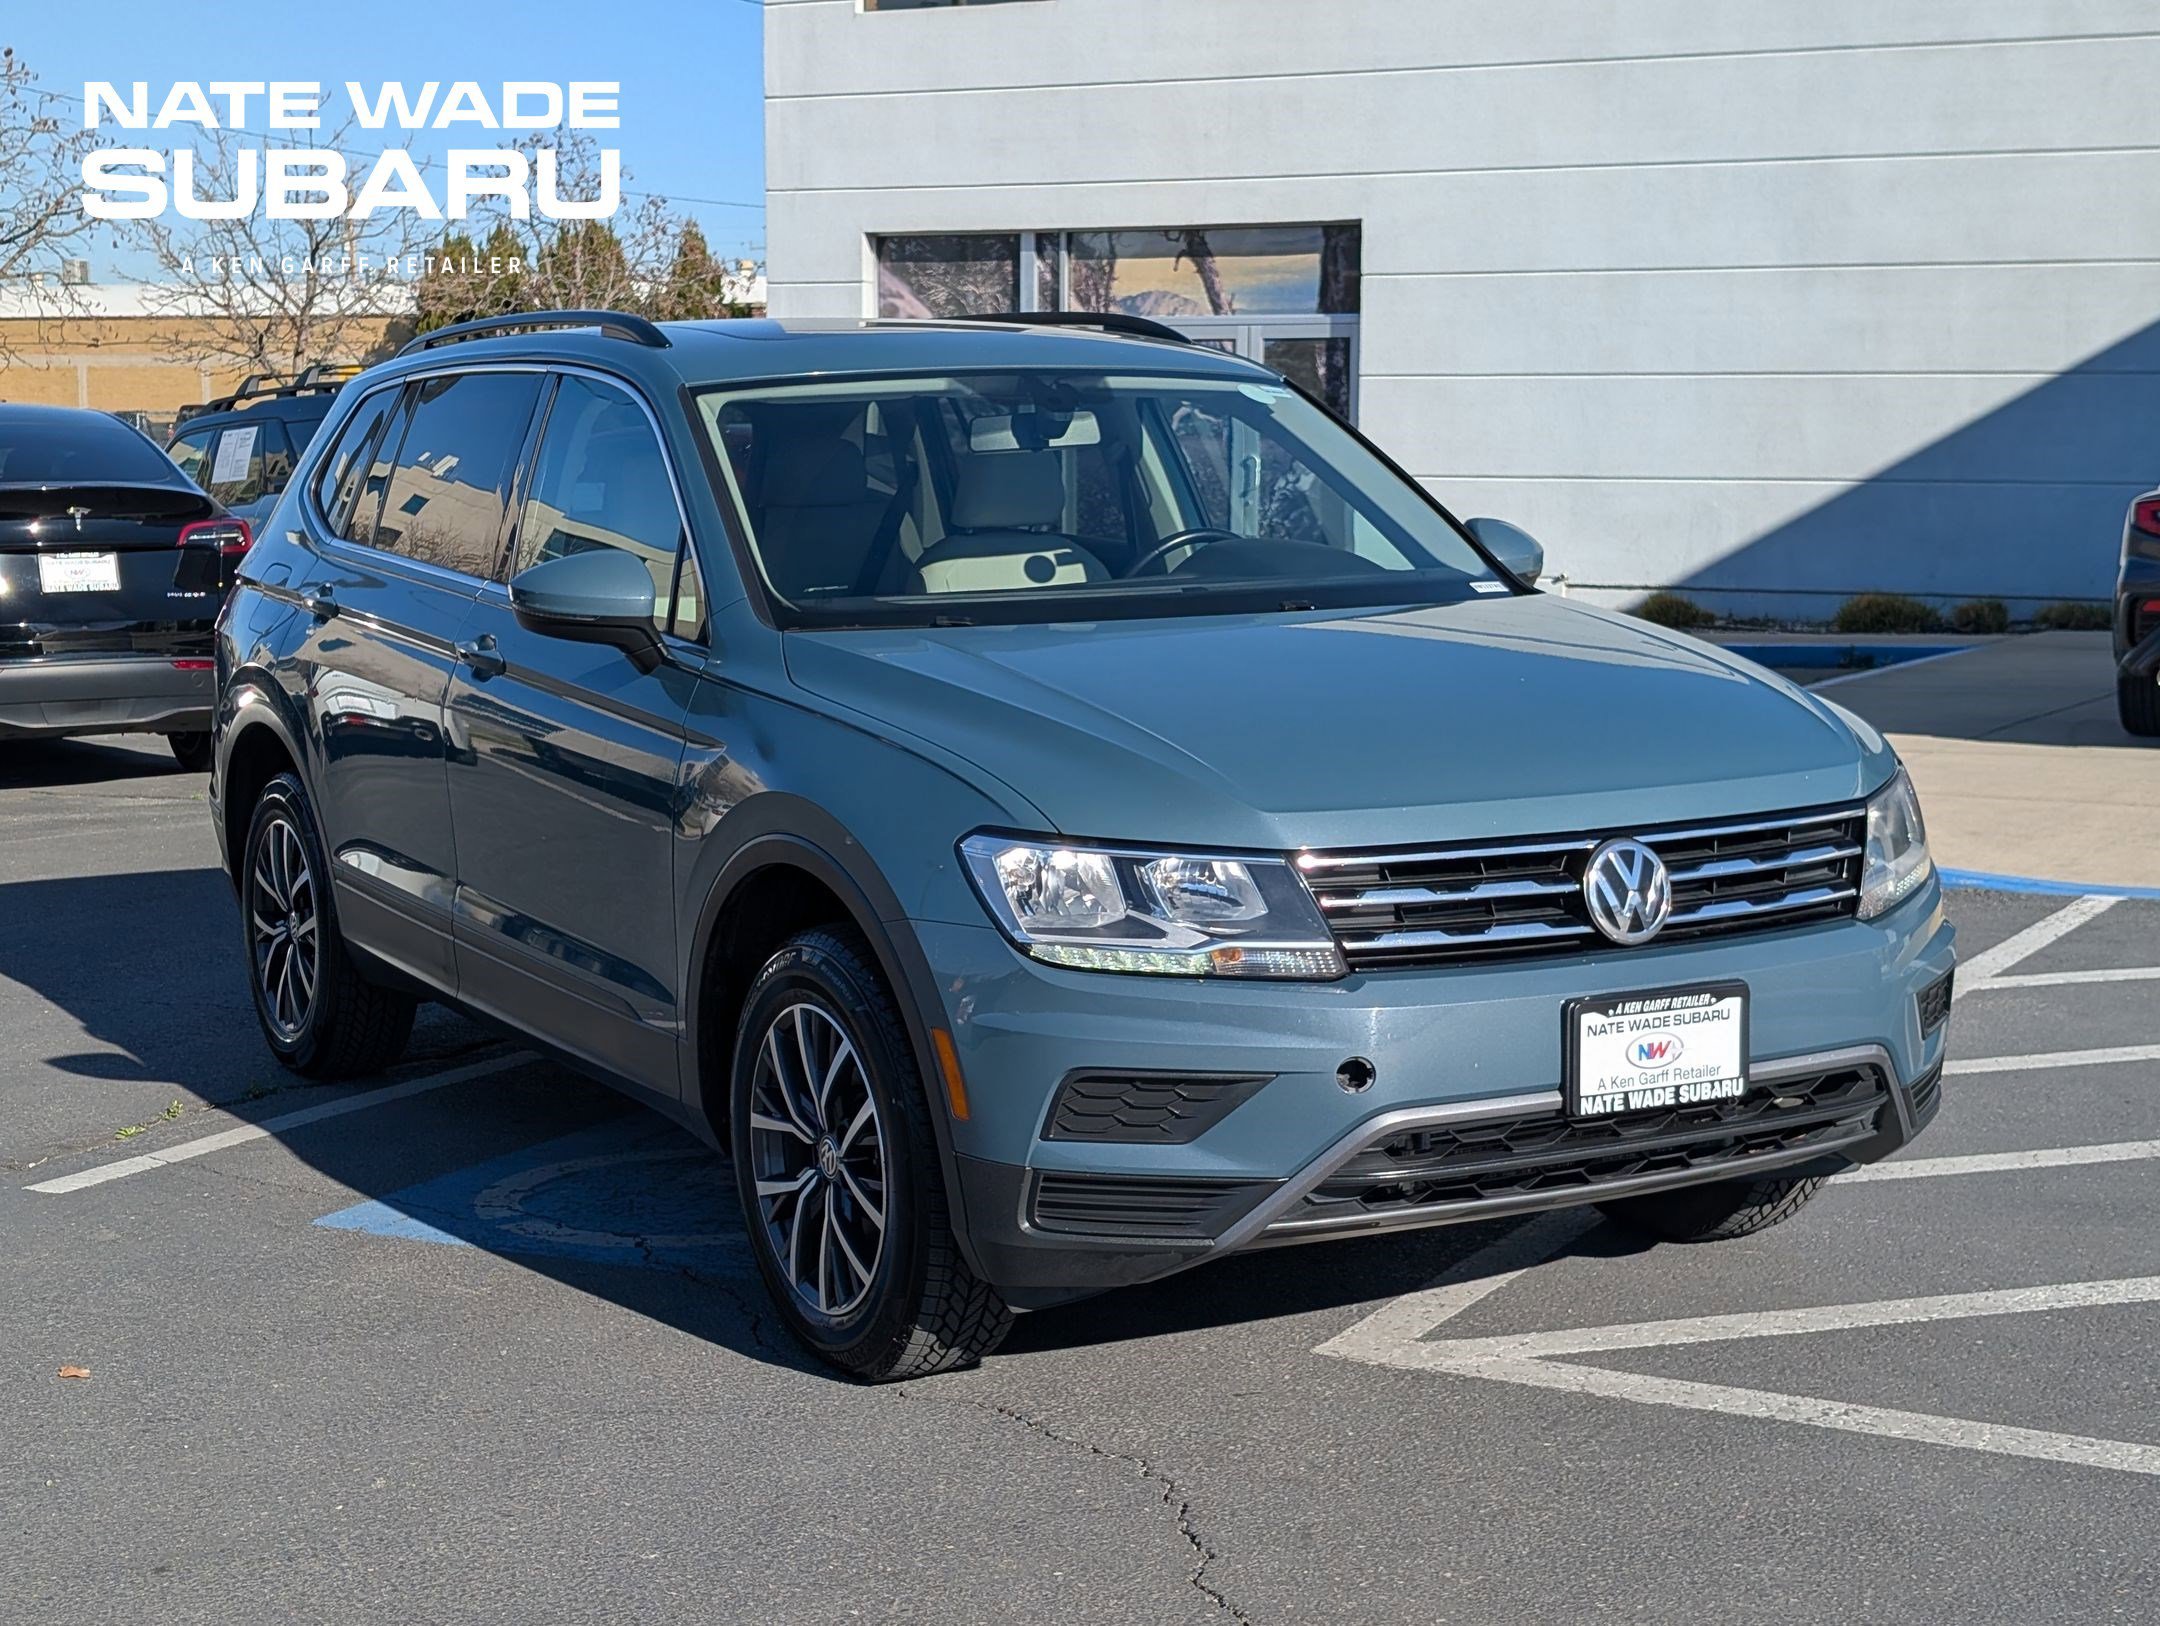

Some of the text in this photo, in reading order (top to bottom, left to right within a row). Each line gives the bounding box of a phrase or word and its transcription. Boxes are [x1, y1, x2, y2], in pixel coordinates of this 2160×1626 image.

[1615, 993, 1711, 1015] A KEN GARFF RETAILER
[1587, 1008, 1731, 1037] NATE WADE SUBARU
[1638, 1040, 1672, 1061] NW
[1597, 1064, 1722, 1091] A Ken Garff Retailer
[1580, 1077, 1744, 1116] NATE WADE SUBARU
